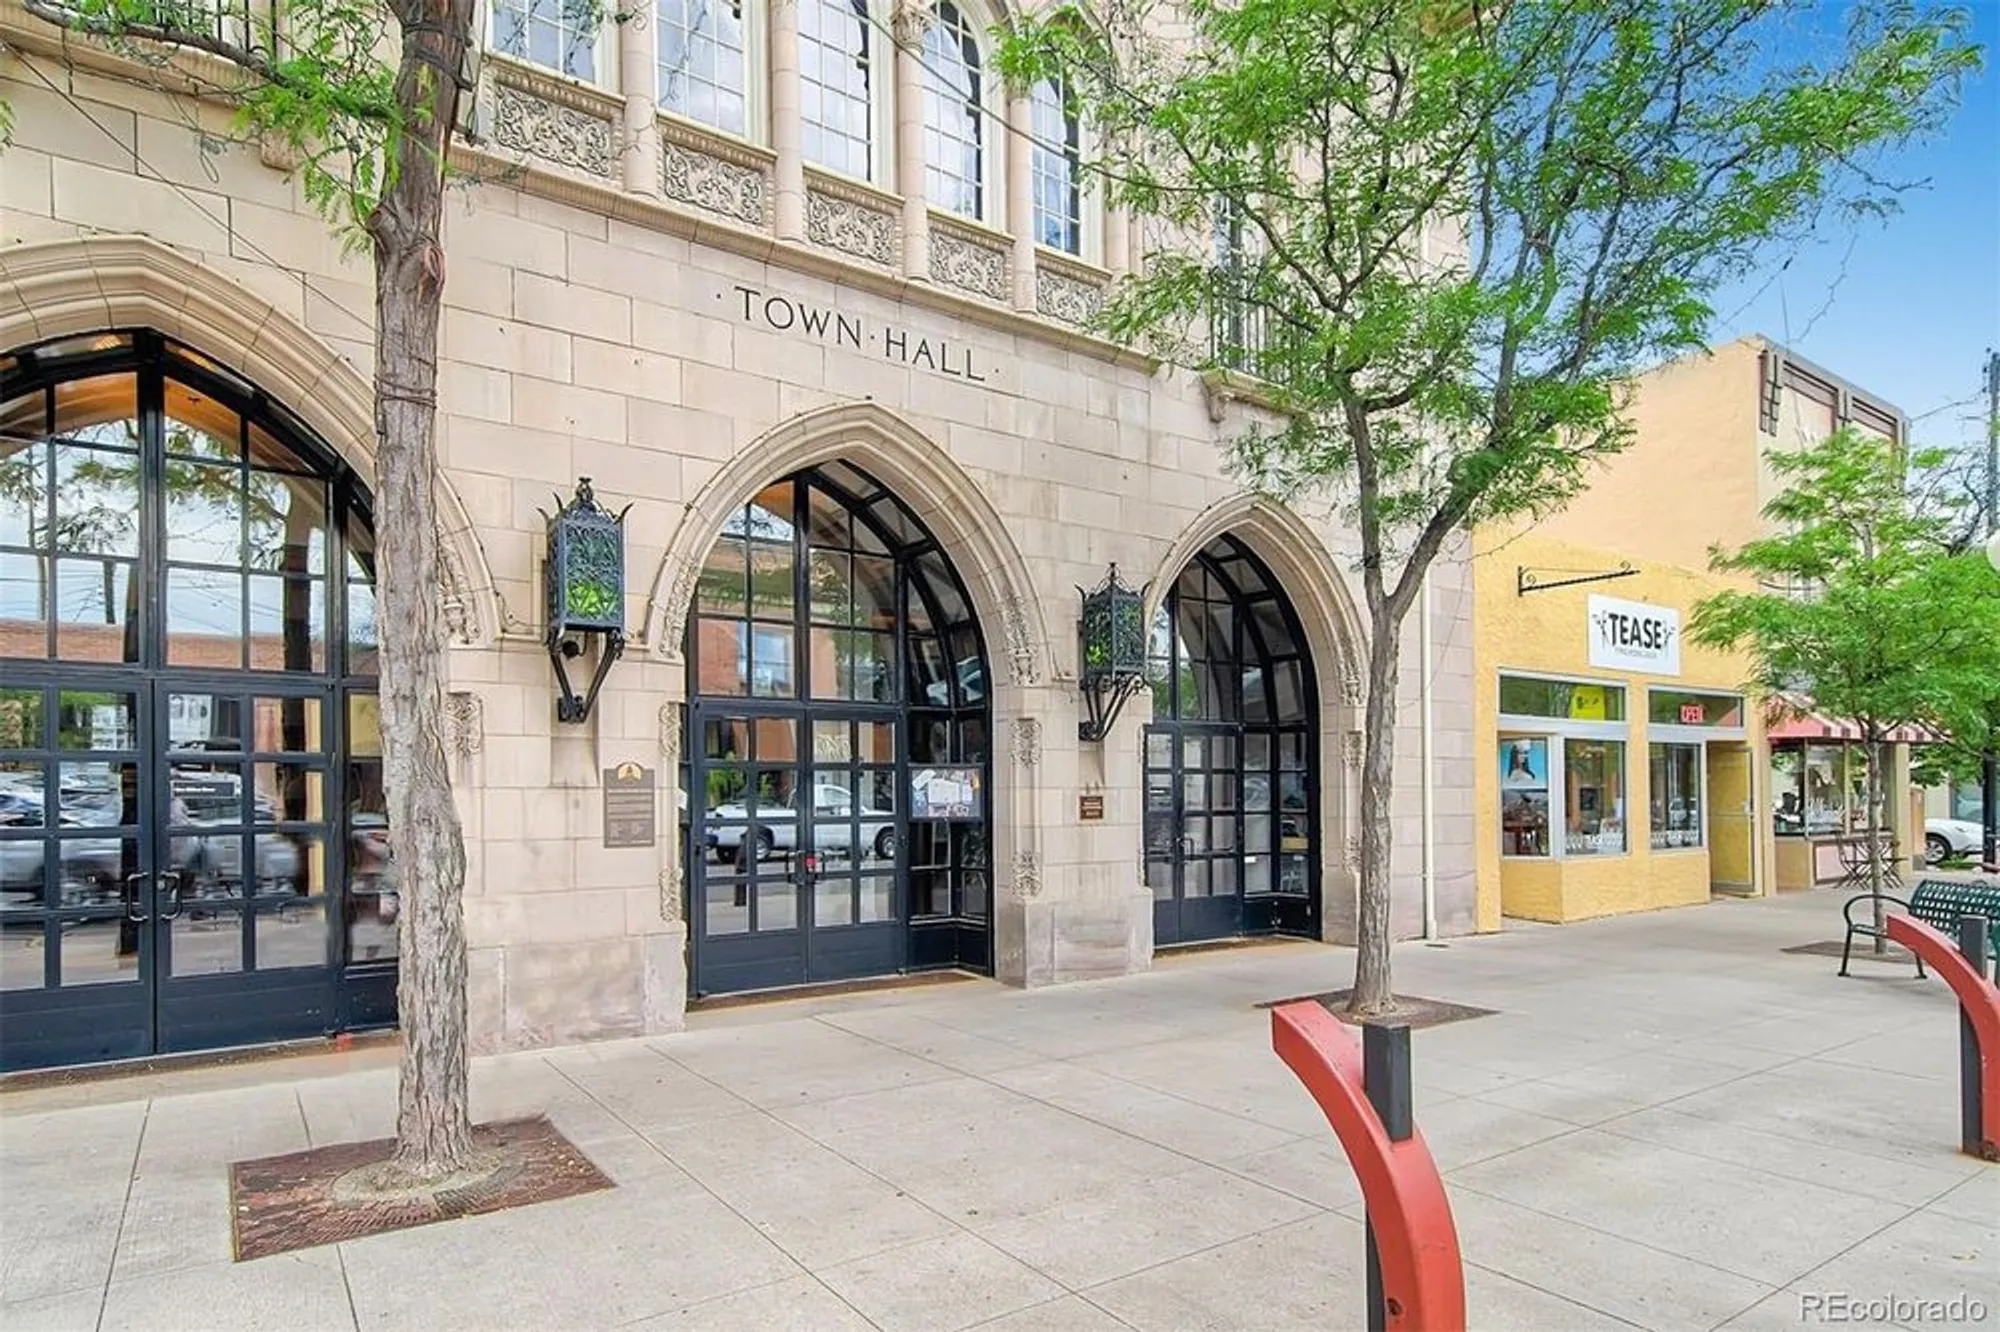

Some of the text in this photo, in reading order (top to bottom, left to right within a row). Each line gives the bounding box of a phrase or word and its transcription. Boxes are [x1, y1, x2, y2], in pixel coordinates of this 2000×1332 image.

[734, 286, 985, 381] TOWN HALL
[1608, 612, 1662, 650] TEASE
